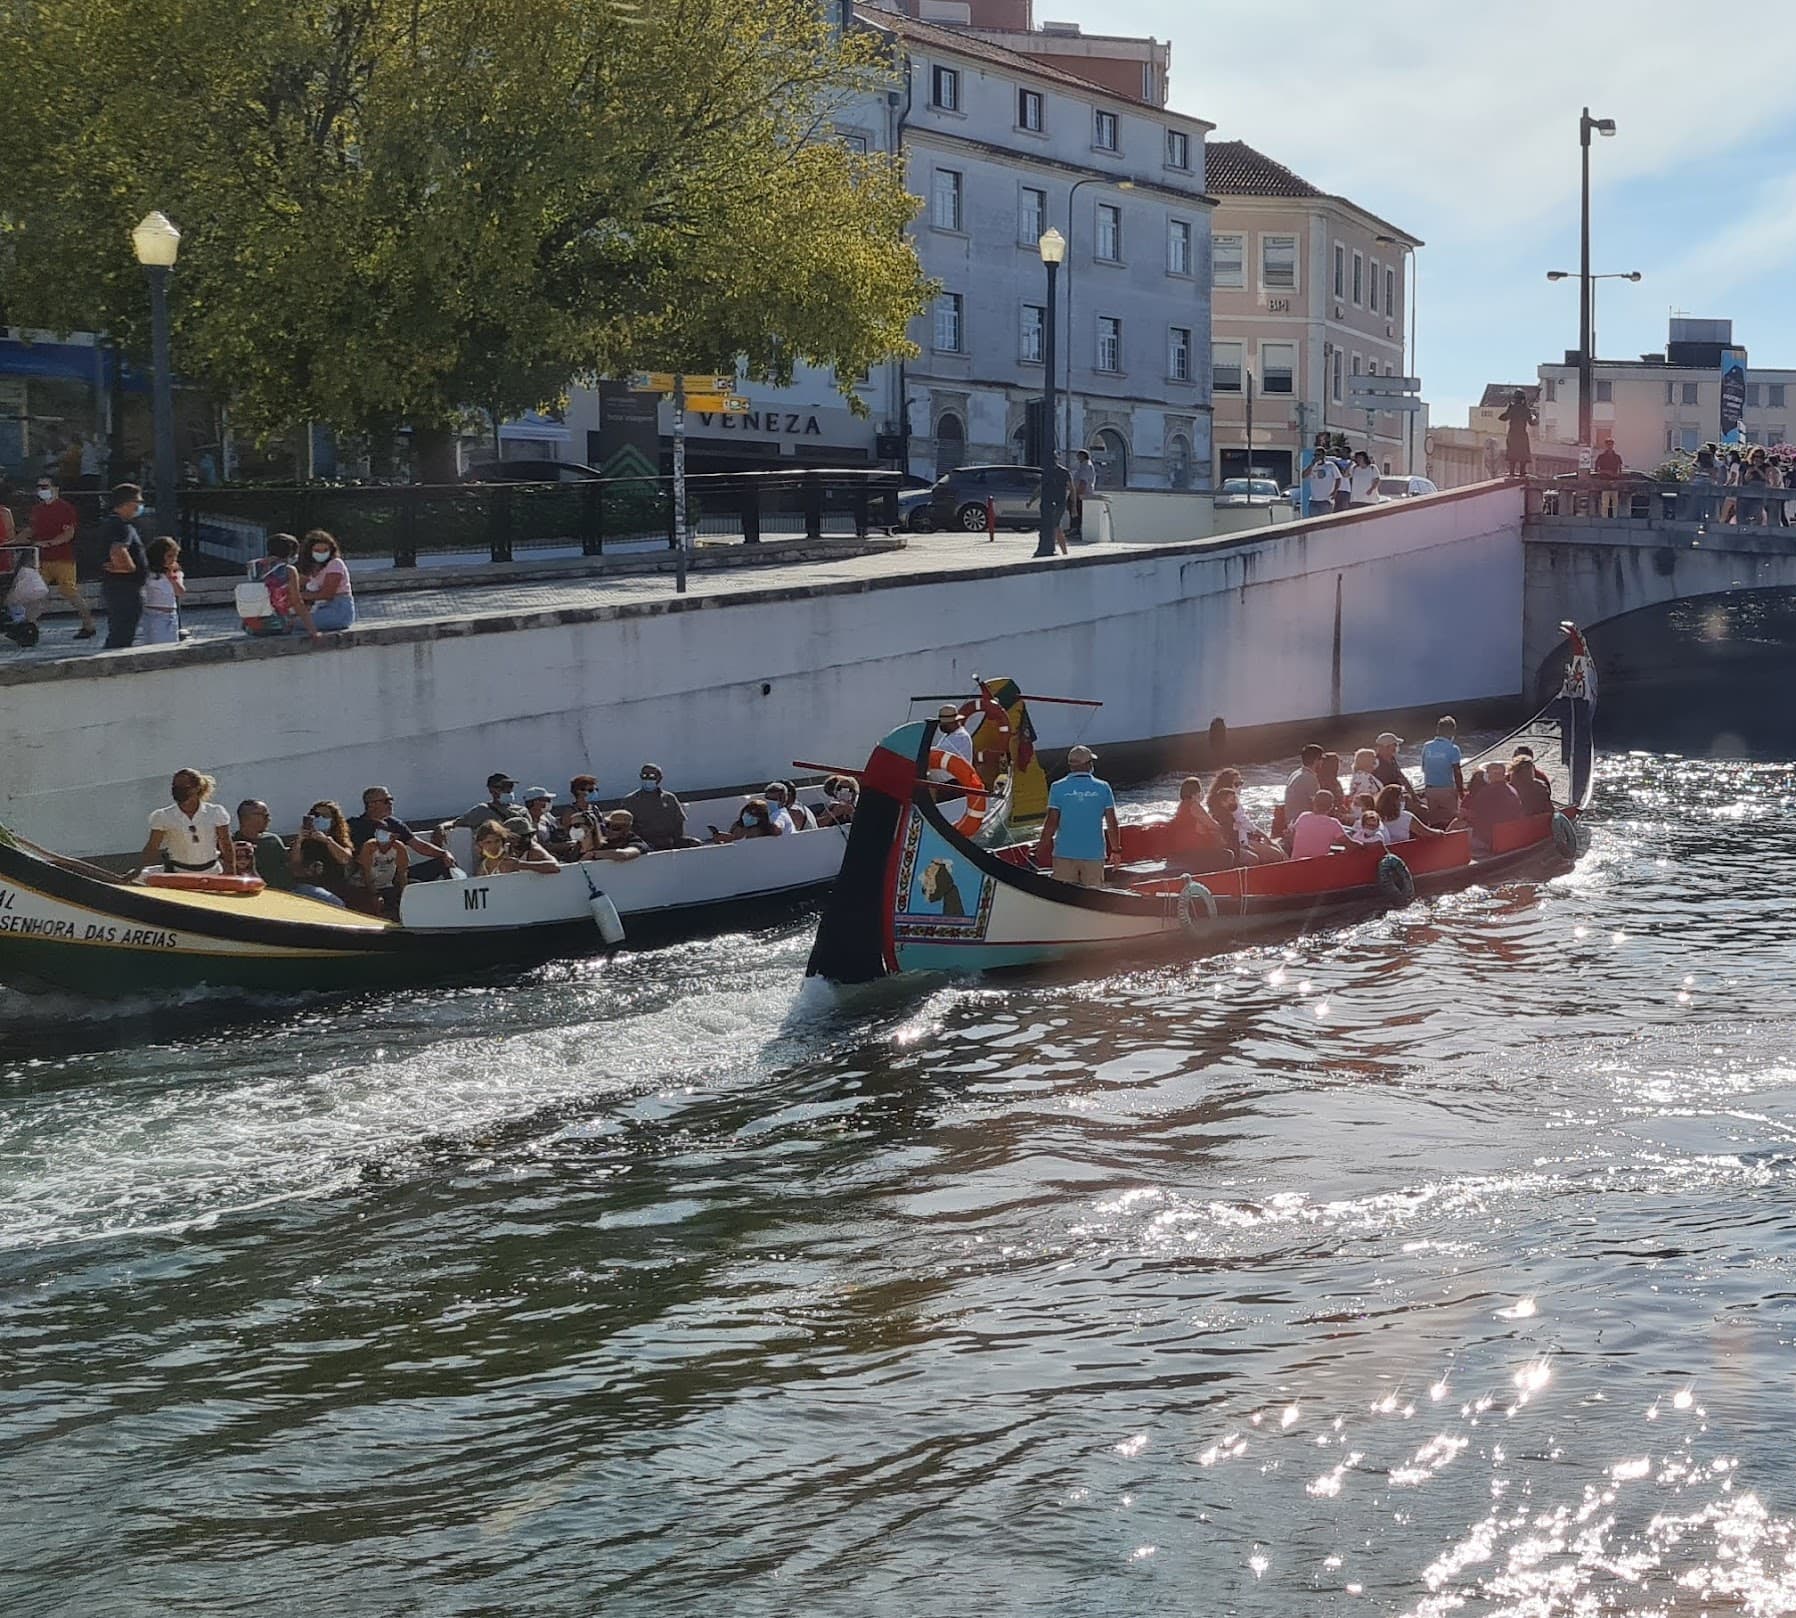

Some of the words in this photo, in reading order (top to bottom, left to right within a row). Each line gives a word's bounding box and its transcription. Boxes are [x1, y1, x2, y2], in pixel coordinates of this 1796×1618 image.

[700, 411, 821, 435] VENEZA
[463, 887, 490, 911] MT
[0, 915, 74, 940] SENHORA
[85, 923, 117, 943] DAS
[120, 928, 177, 948] AREIAS
